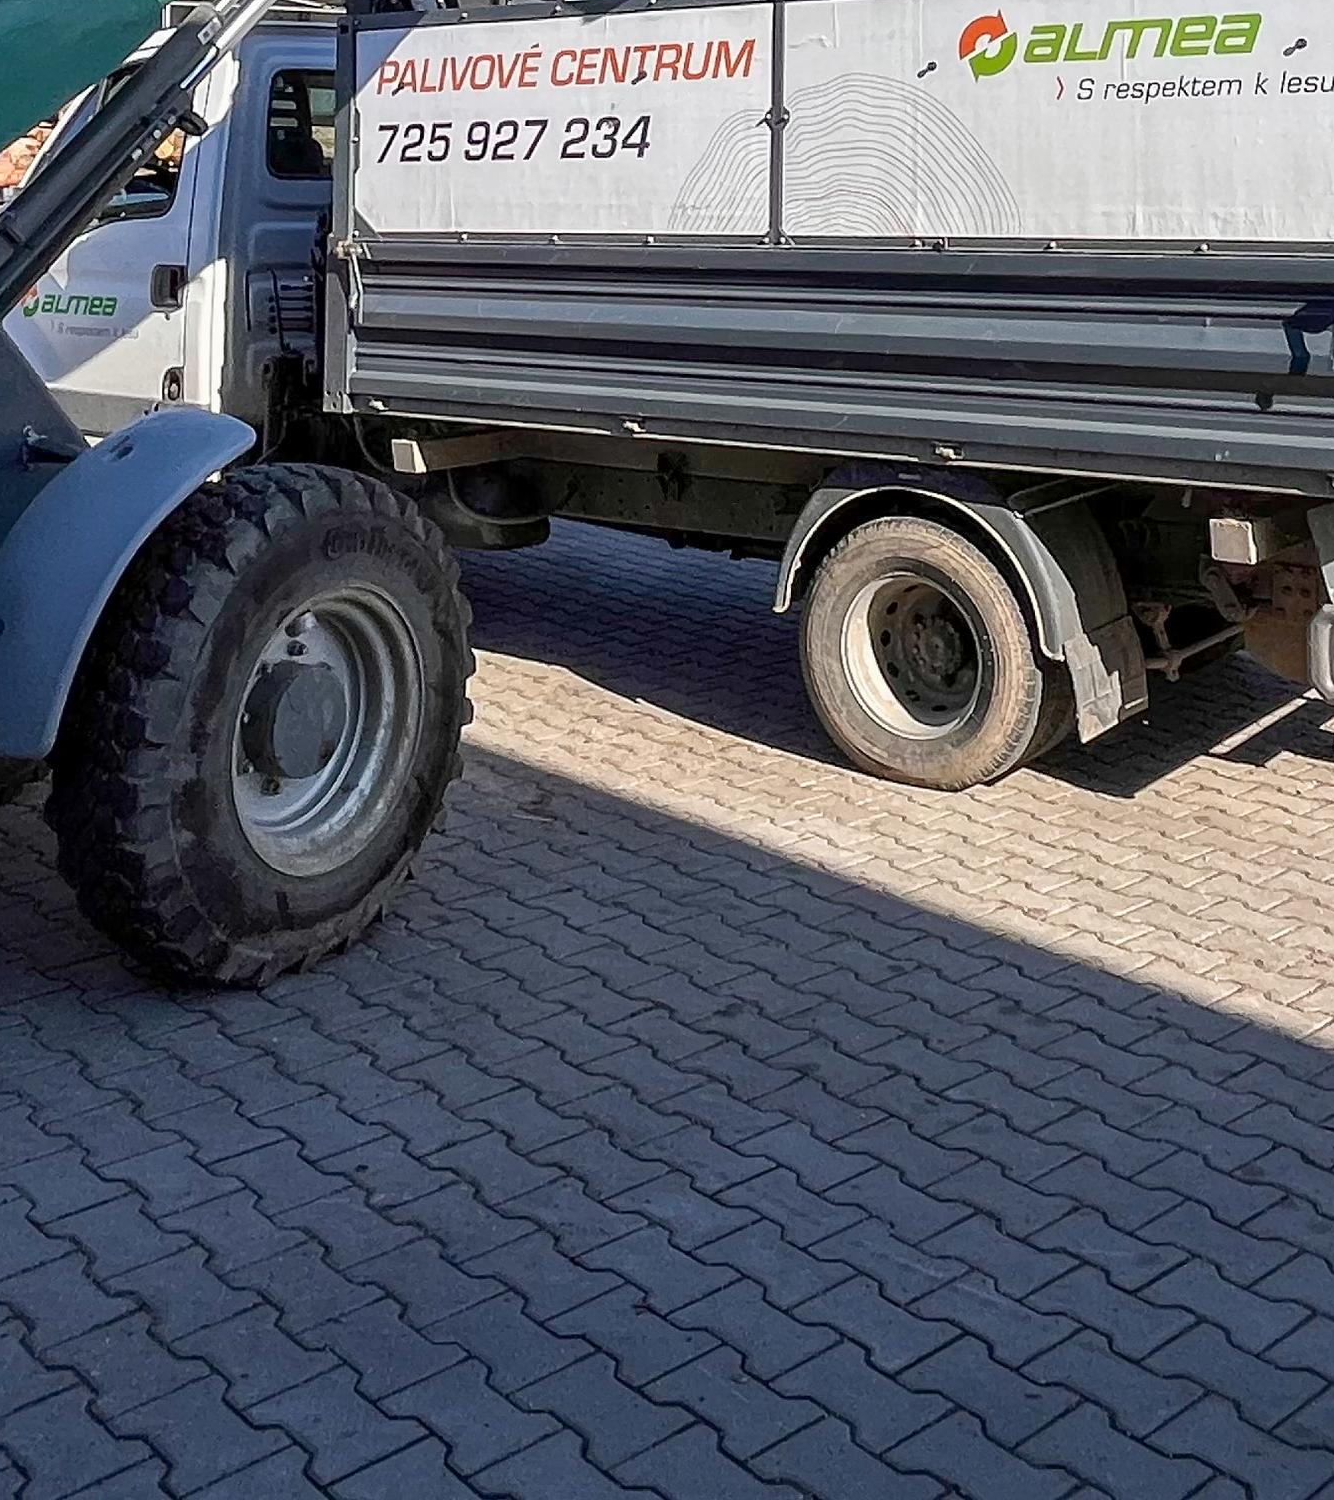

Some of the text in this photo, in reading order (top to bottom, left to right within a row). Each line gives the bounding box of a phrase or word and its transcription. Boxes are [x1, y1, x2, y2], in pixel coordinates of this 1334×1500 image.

[1023, 12, 1263, 63] almea
[376, 38, 756, 96] PALIVOVÉ CENTRUM
[1077, 77, 1096, 100] S
[1103, 76, 1243, 104] respektem
[1254, 72, 1269, 95] k
[376, 115, 651, 164] 725 927 234
[40, 294, 119, 317] almea
